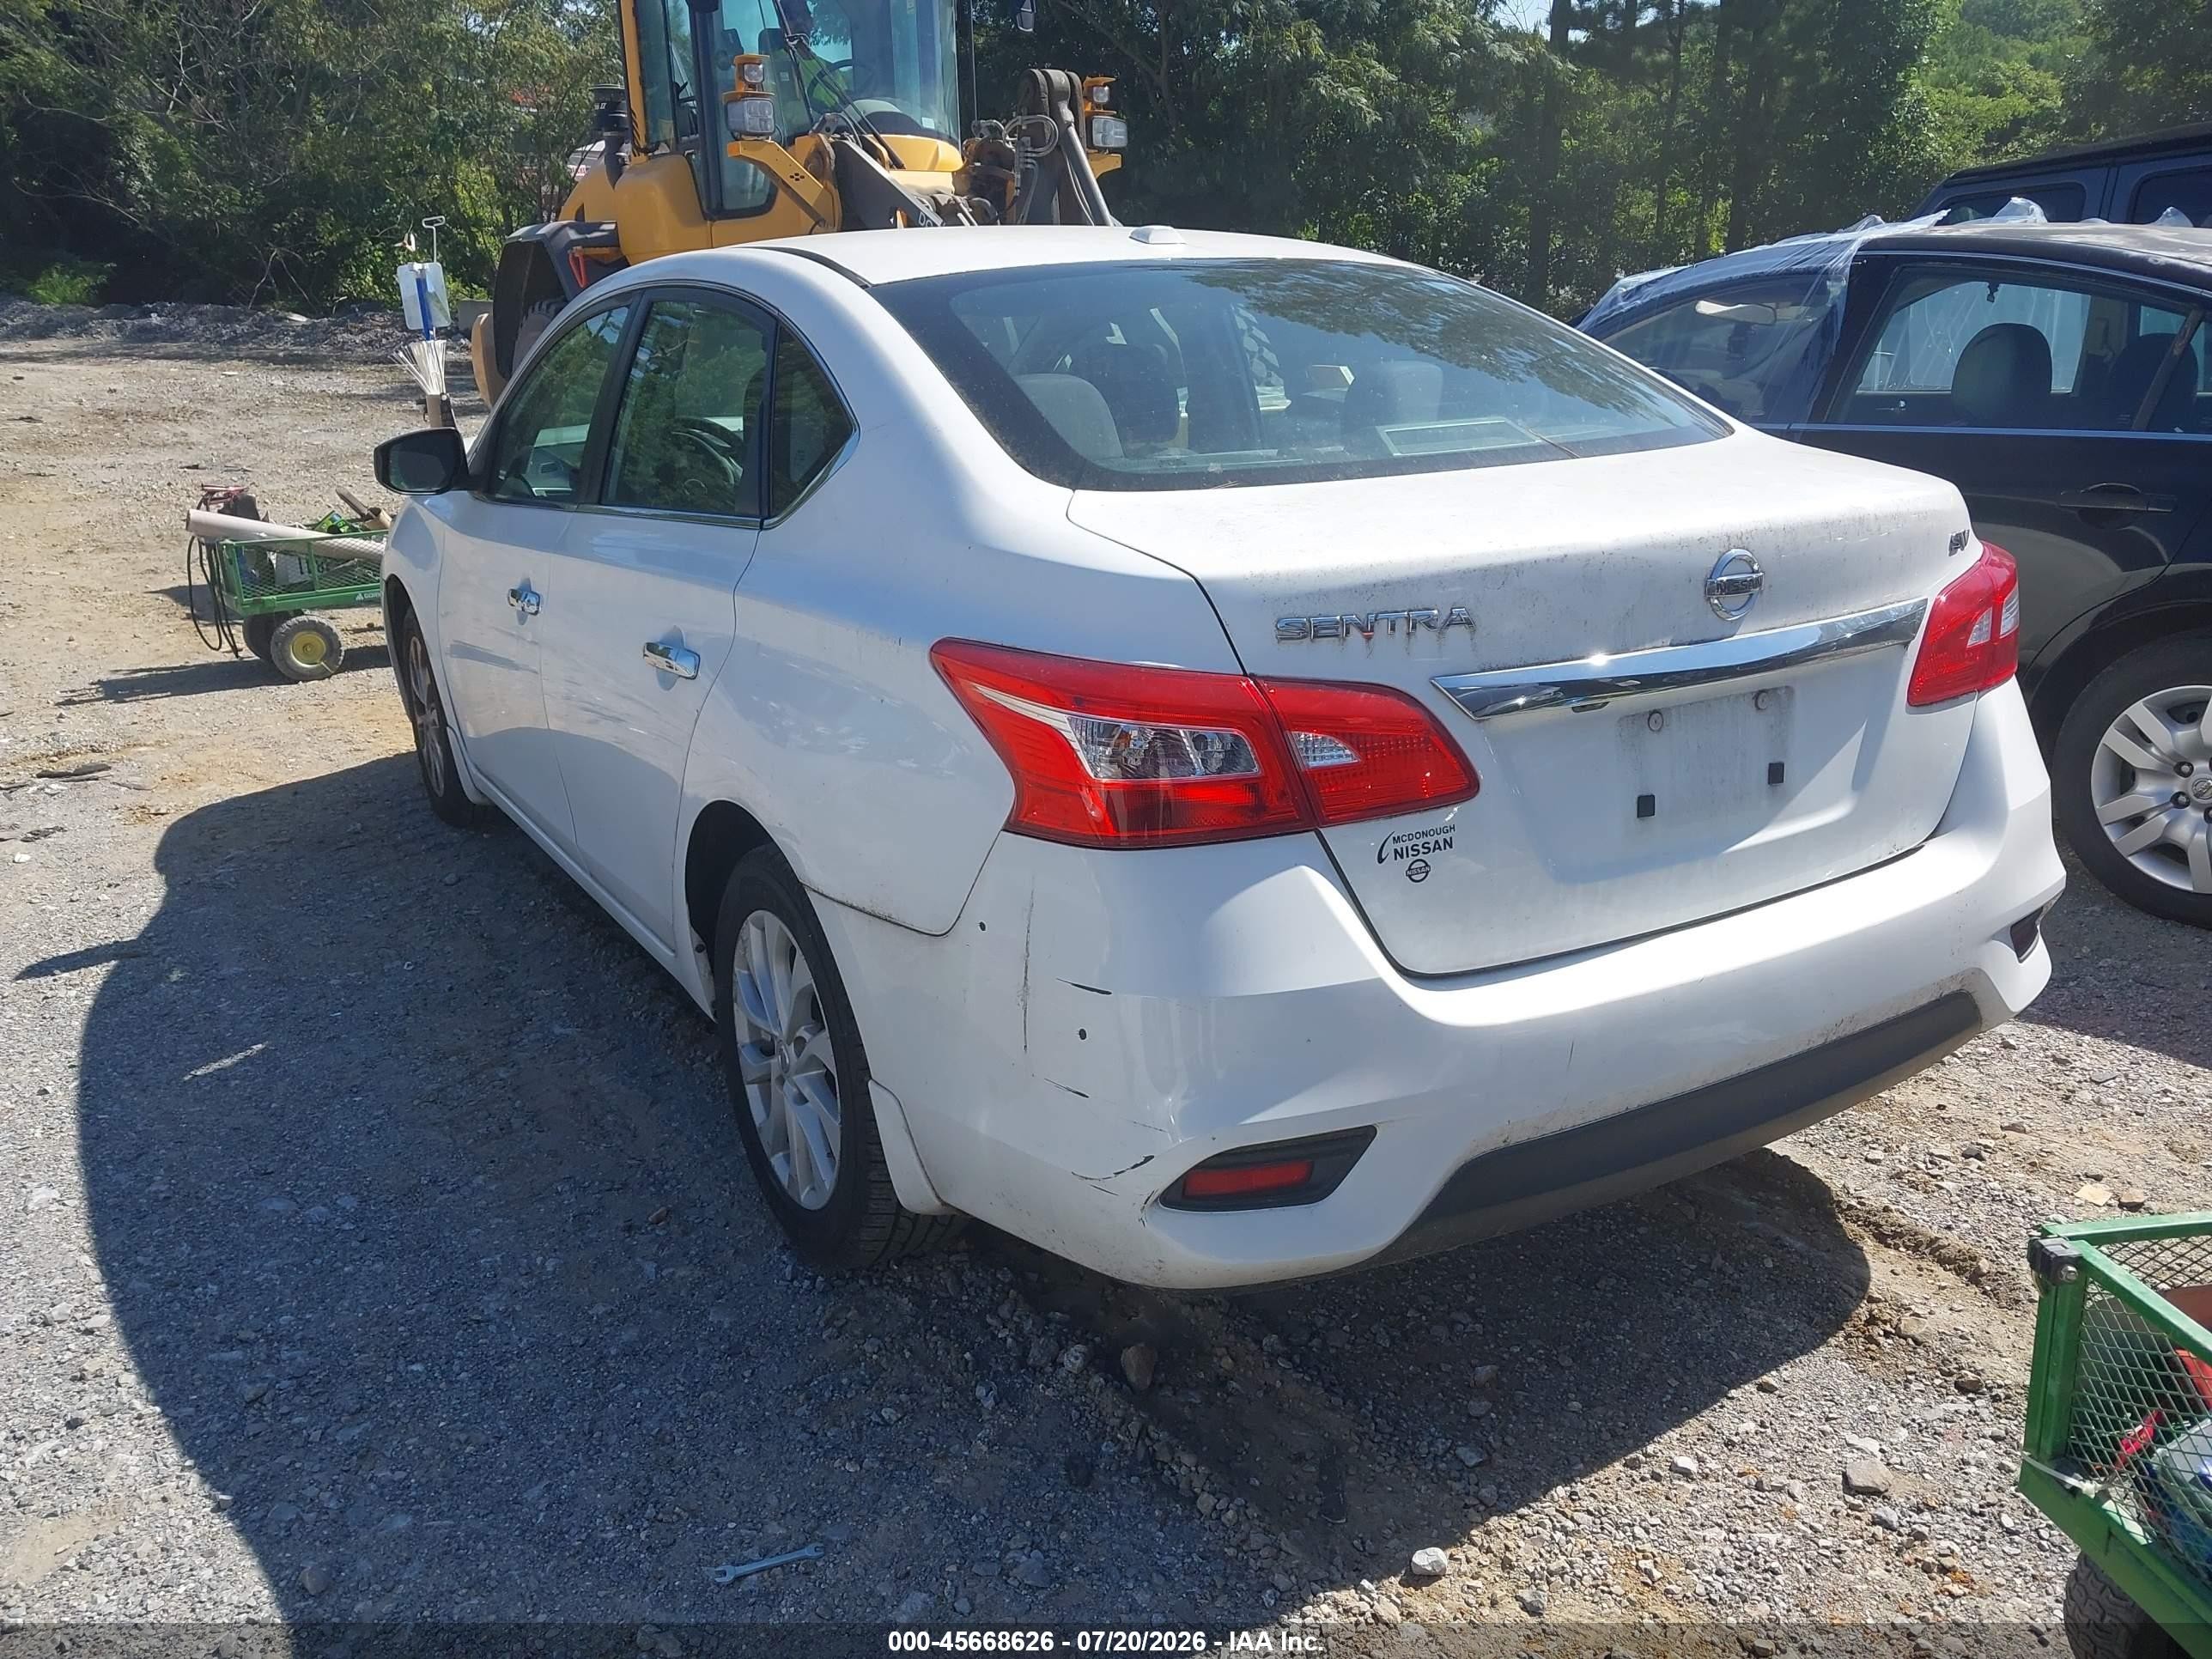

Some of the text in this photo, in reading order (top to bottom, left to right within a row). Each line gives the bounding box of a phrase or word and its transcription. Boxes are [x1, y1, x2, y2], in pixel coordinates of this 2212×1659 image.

[1948, 529, 1970, 556] SV
[1275, 607, 1476, 640] SENTRA
[1392, 824, 1455, 844] MCDONOUGH
[1393, 836, 1453, 860] NISSAN
[1407, 866, 1431, 876] NISSAN
